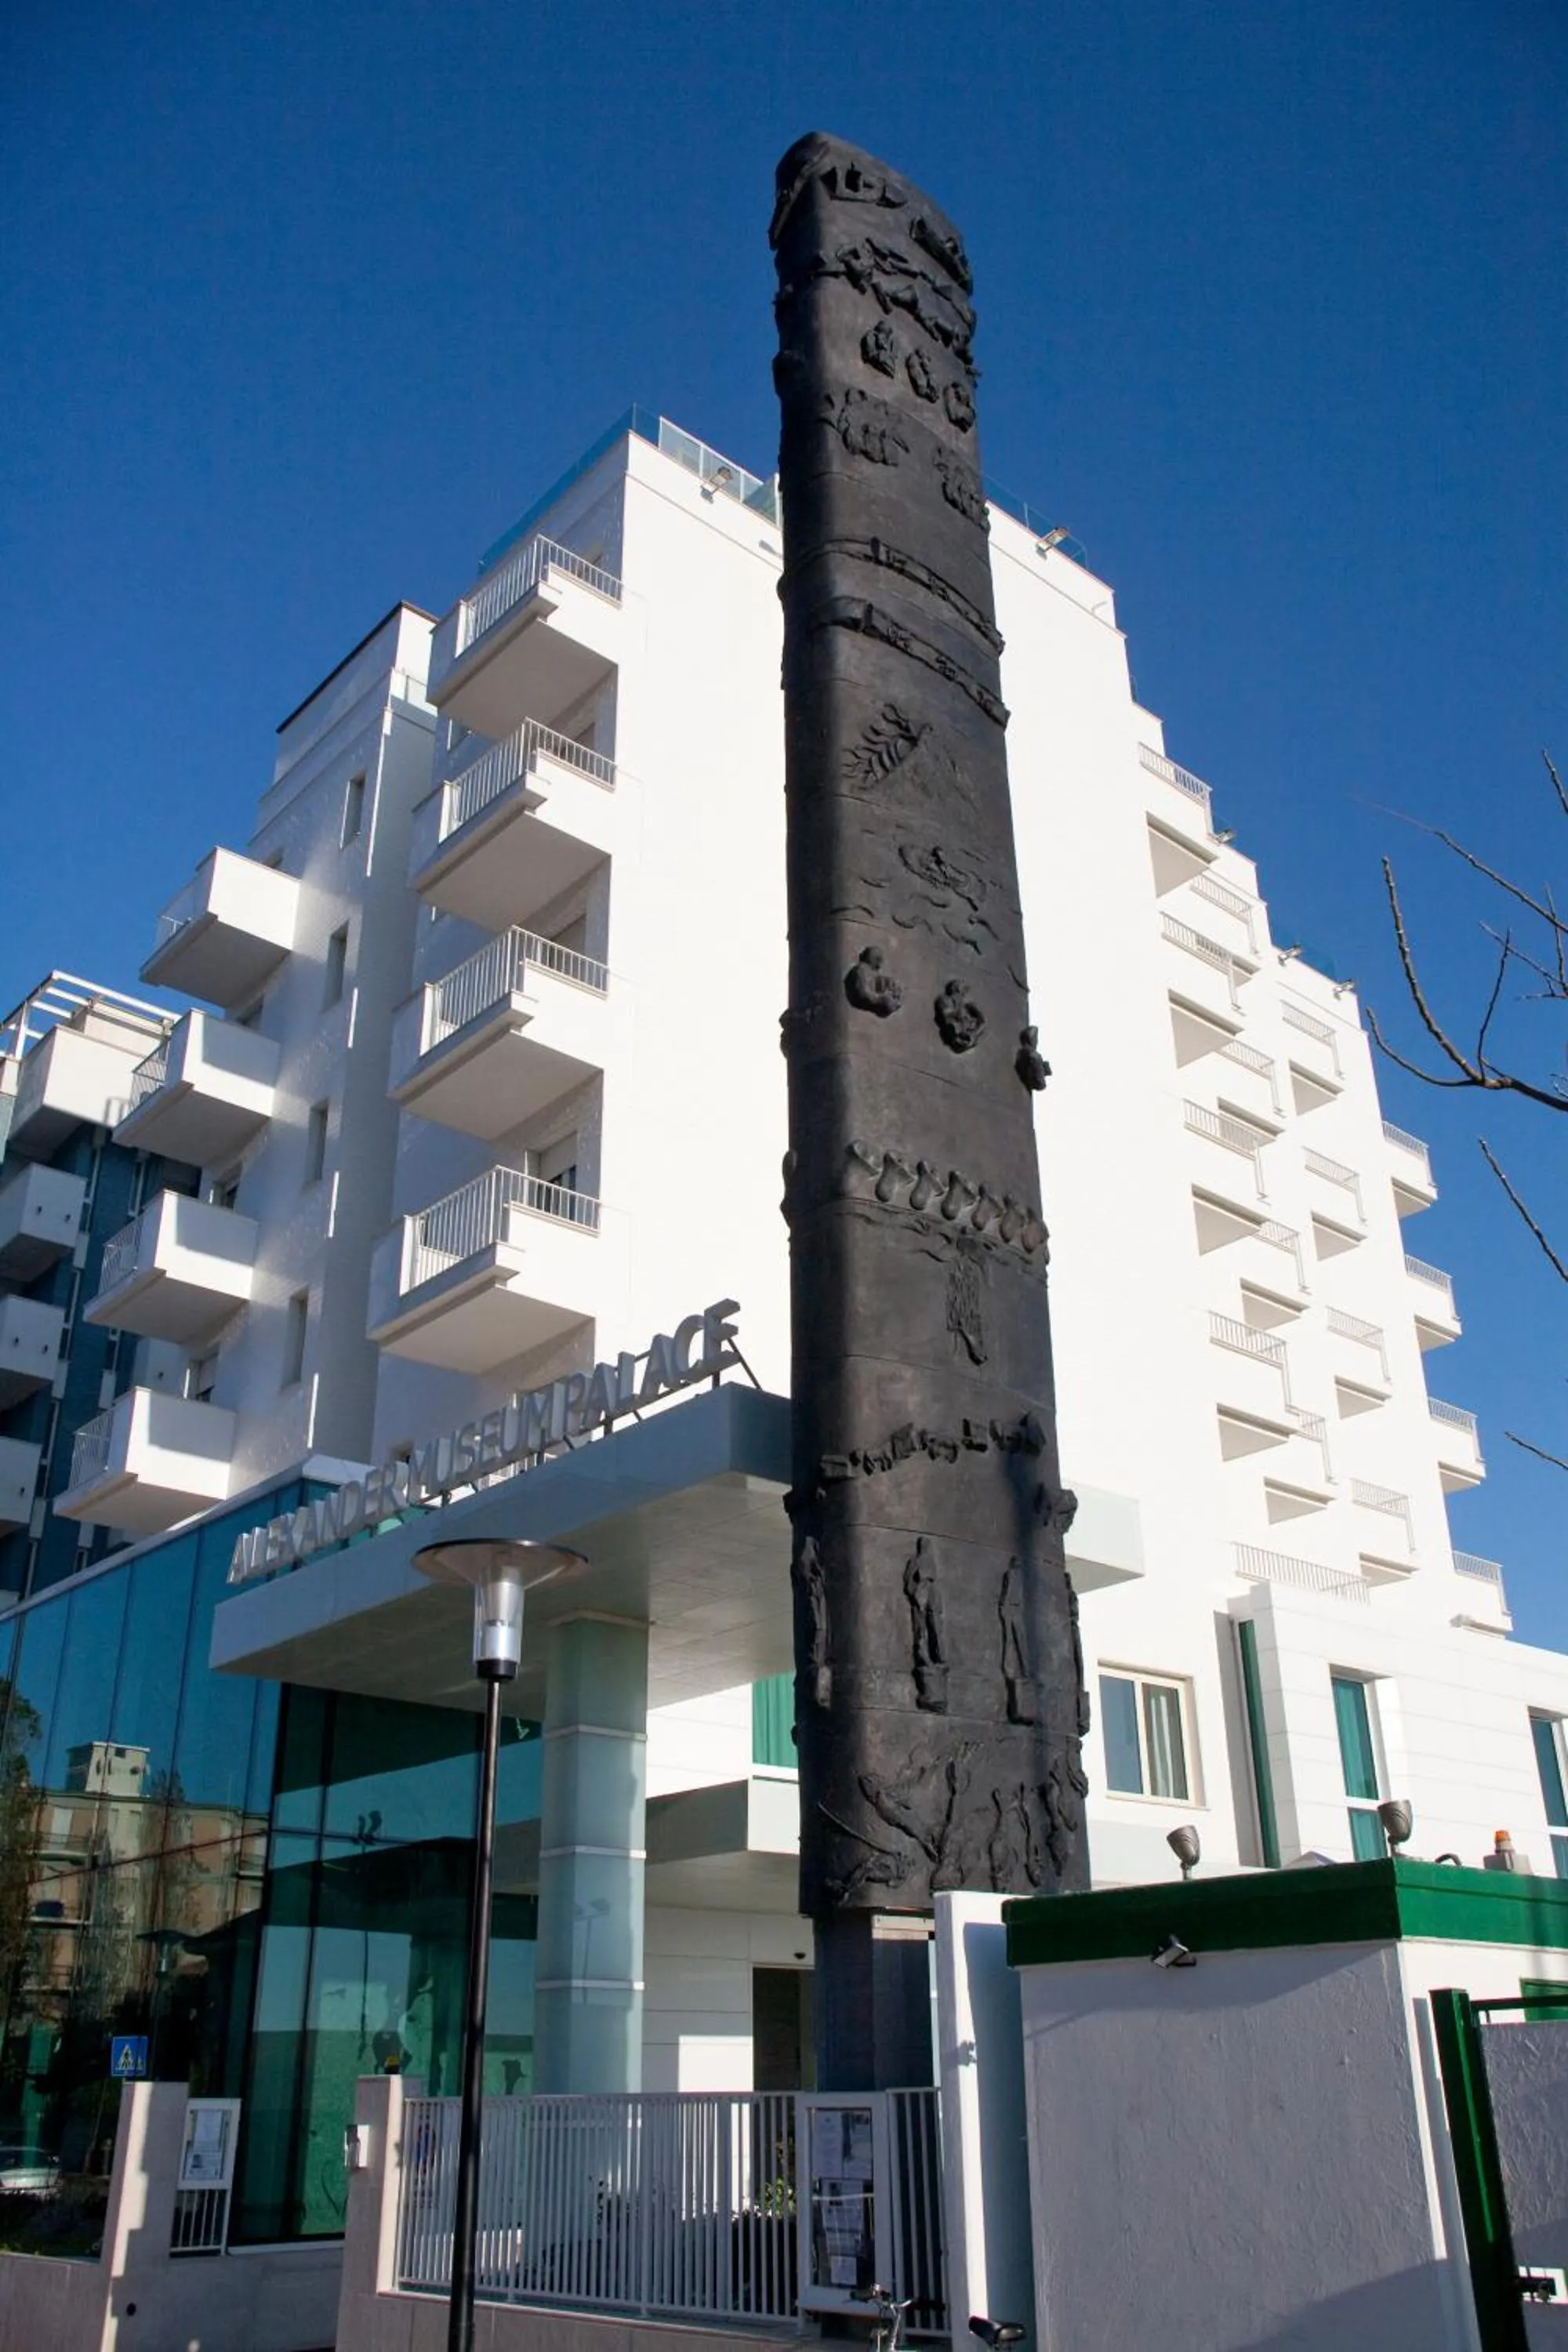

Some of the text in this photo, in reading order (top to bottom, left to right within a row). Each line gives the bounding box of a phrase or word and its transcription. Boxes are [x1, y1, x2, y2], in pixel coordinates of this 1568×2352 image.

[226, 1298, 741, 1584] ALEXANDER MUSEUM PALACE
